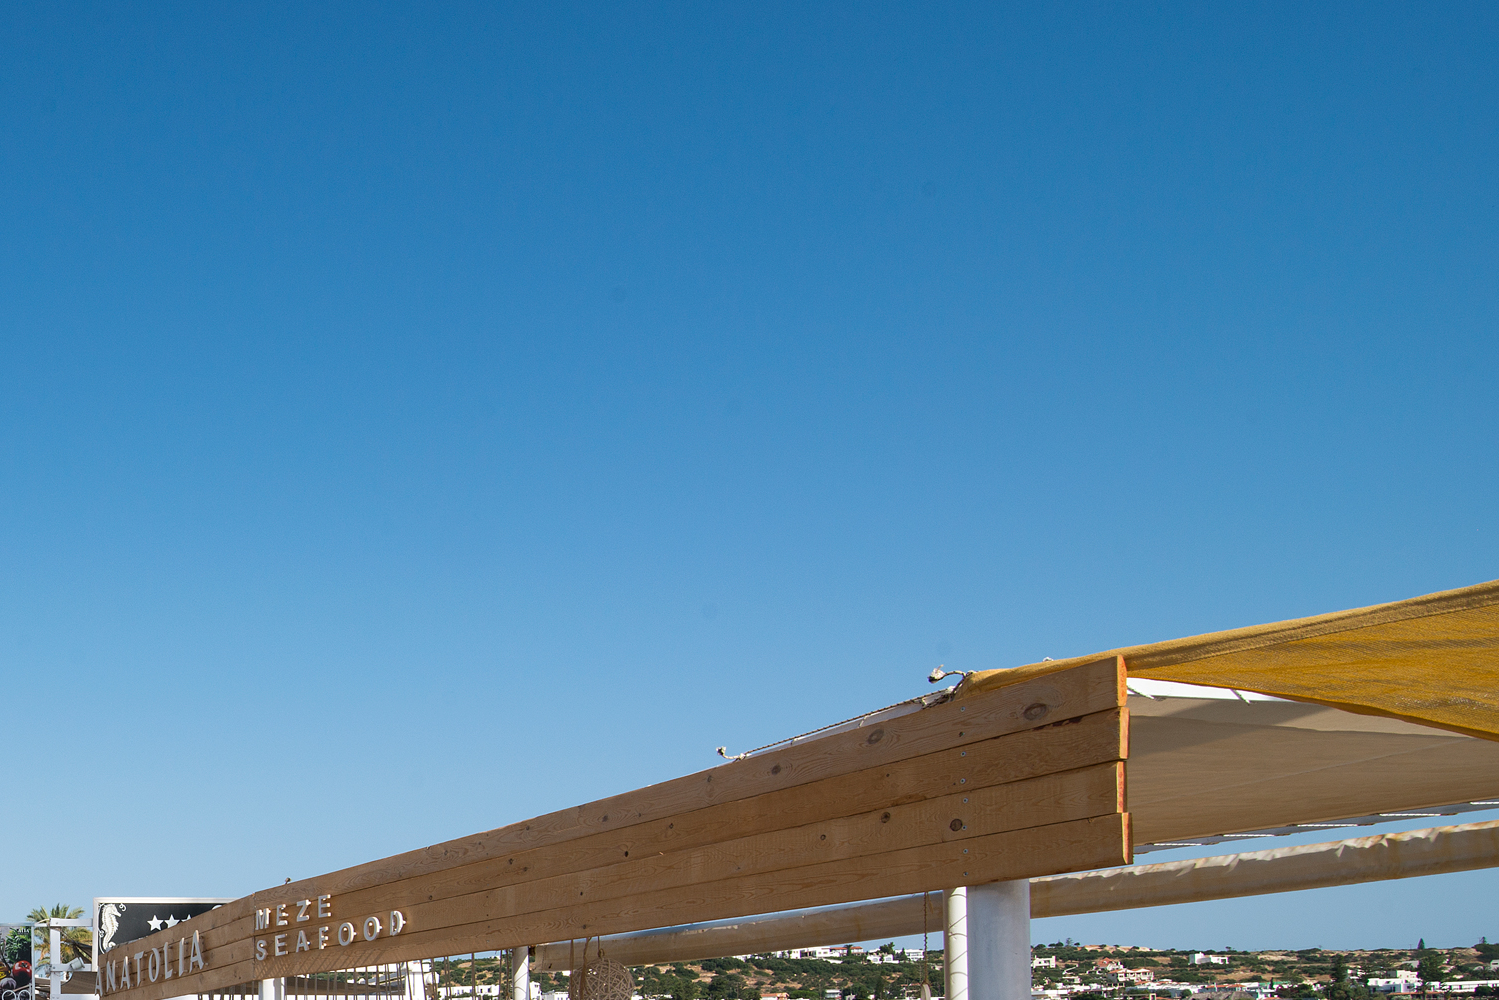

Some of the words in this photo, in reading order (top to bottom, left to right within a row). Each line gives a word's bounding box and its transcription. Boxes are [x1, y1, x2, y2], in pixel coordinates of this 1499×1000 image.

[255, 894, 332, 931] MEZE
[256, 910, 406, 961] SEAFOOD
[94, 929, 205, 997] ANATOLIA
